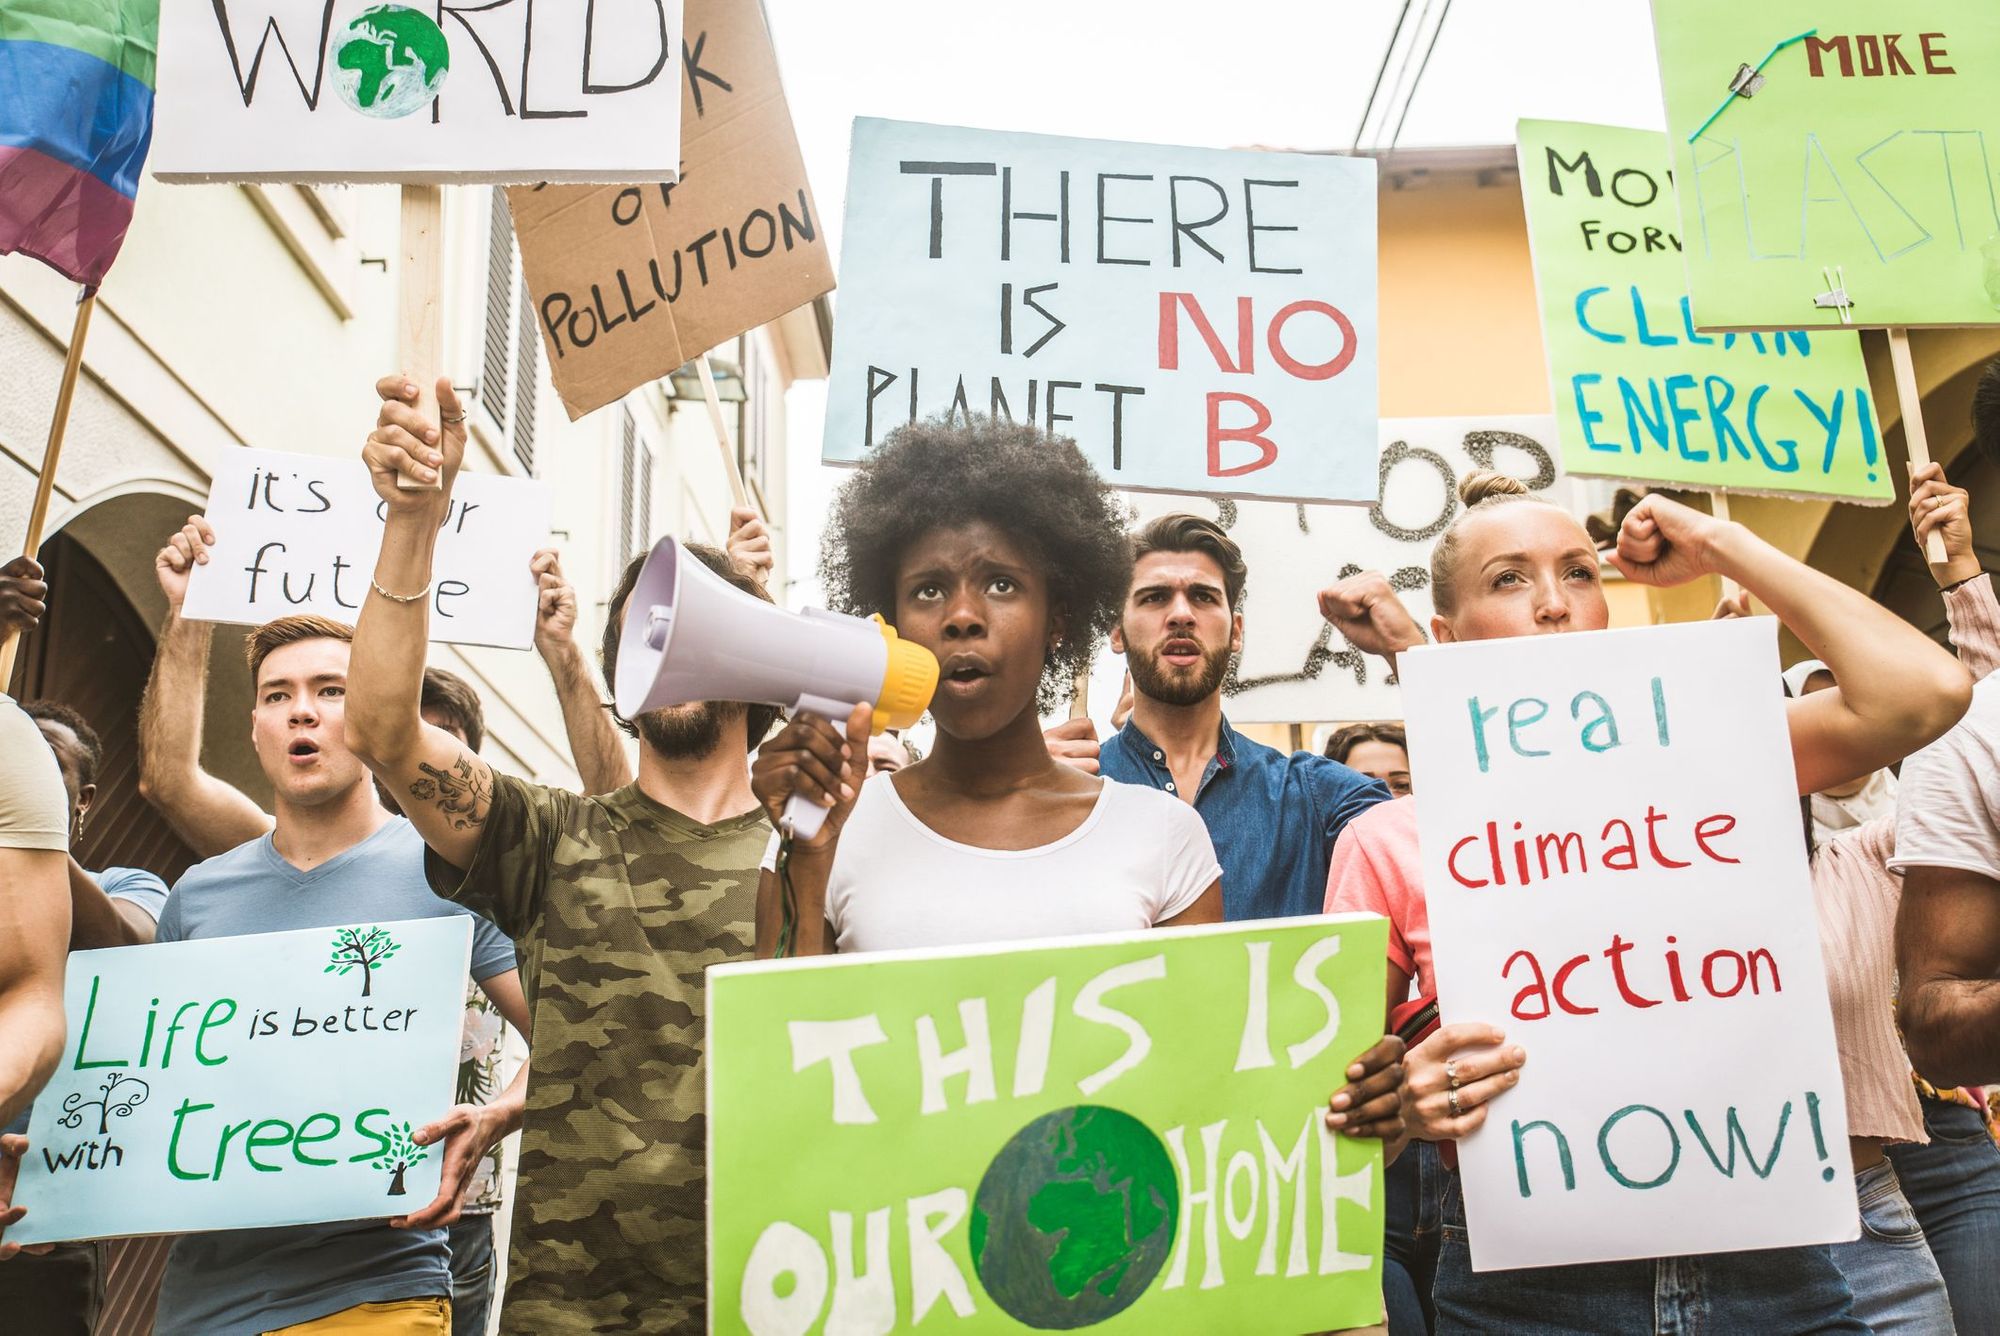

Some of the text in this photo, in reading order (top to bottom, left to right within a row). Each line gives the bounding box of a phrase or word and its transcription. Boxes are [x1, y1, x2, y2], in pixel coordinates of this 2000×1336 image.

[1804, 33, 1956, 77] MORE
[900, 161, 1303, 274] THERE
[1689, 129, 2000, 264] PLASTI
[541, 189, 816, 359] POLLUTION
[1001, 283, 1357, 381] IS NO
[1206, 392, 1278, 477] B
[1572, 373, 1878, 482] ENERGY!
[248, 467, 331, 512] it's
[245, 542, 470, 618] fute
[1467, 677, 1670, 773] real
[1448, 806, 1740, 889] climate
[73, 975, 417, 1071] Life is better
[1501, 934, 1782, 1021] action
[787, 934, 1341, 1125] THIS IS
[43, 1097, 393, 1183] with trees
[1511, 1092, 1835, 1199] now!
[741, 1106, 1373, 1336] OUR HOME
